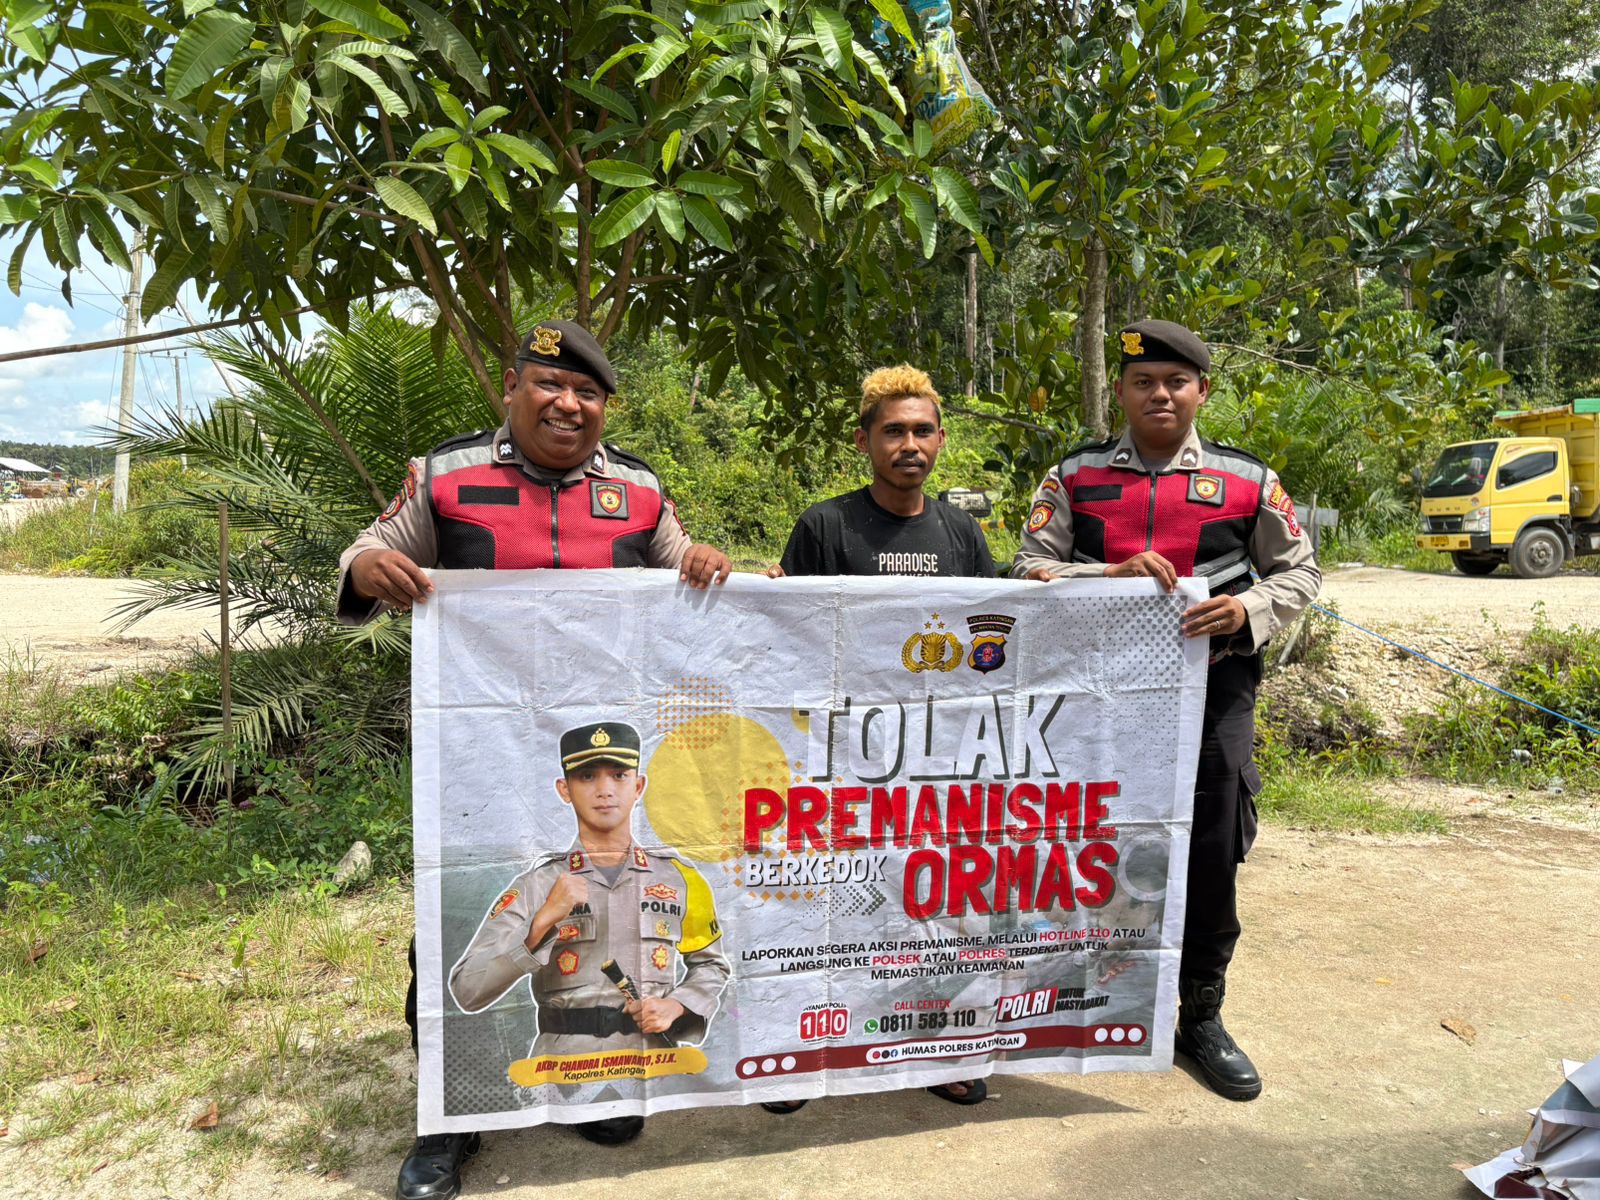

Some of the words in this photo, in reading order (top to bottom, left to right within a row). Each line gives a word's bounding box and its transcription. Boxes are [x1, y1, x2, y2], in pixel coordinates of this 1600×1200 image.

[878, 552, 938, 573] PARADISE
[794, 691, 1066, 783] TOLAK
[744, 780, 1121, 854] PREMANISME
[745, 855, 887, 888] BERKEDOK
[902, 841, 1120, 922] ORMAS
[641, 901, 681, 916] POLRI
[742, 946, 814, 961] LAPORKAN
[816, 943, 866, 956] SEGERA
[868, 941, 897, 952] AKSI
[900, 936, 985, 951] PREMANISME,
[987, 932, 1037, 945] MELALUI
[1040, 928, 1087, 941] HOTLINE
[1088, 928, 1110, 938] 110
[1113, 928, 1146, 938] ATAU
[781, 957, 851, 972] LANGSUNG
[854, 956, 870, 967] KE
[872, 954, 921, 966] POLSEK
[923, 952, 957, 963] ATAU
[959, 948, 1006, 960] POLRES
[1008, 943, 1067, 957] TERDEKAT
[1069, 941, 1109, 951] UNTUK
[871, 965, 954, 980] MEMASTIKAN
[956, 960, 1025, 974] KEAMANAN
[894, 1001, 915, 1011] CALL
[917, 999, 952, 1011] CENTER
[997, 989, 1052, 1020] POLRI
[802, 1010, 847, 1037] 110
[880, 1013, 913, 1033] 0811
[918, 1011, 948, 1029] 583
[953, 1009, 976, 1027] 110
[902, 1044, 937, 1056] HUMAS
[939, 1042, 974, 1053] POLRES
[975, 1037, 1020, 1050] KATINGAN
[535, 1060, 558, 1072] AKBP
[560, 1058, 600, 1072] CHANDRA
[564, 1069, 605, 1081] Kapolres
[607, 1066, 646, 1078] Katingan
